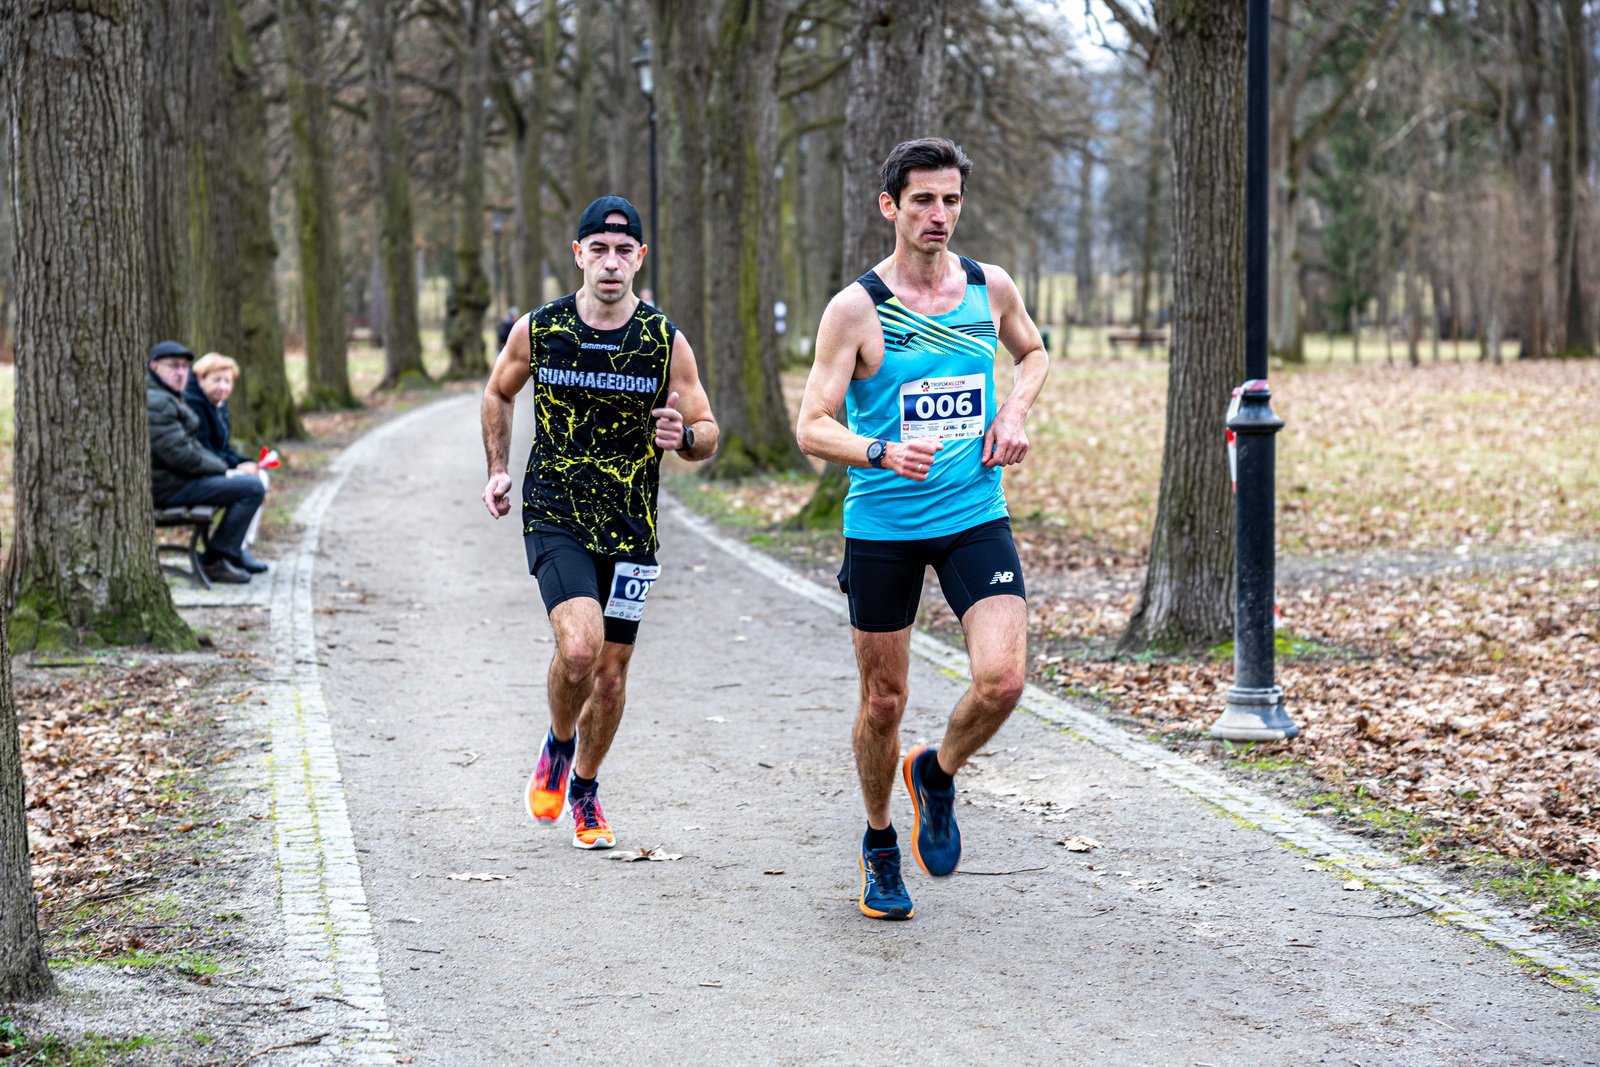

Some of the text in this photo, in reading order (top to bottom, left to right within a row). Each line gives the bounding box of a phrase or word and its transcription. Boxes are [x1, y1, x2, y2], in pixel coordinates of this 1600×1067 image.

[580, 342, 620, 351] SMMASH
[538, 367, 657, 393] RUNMAGEDDON
[915, 392, 973, 419] 006
